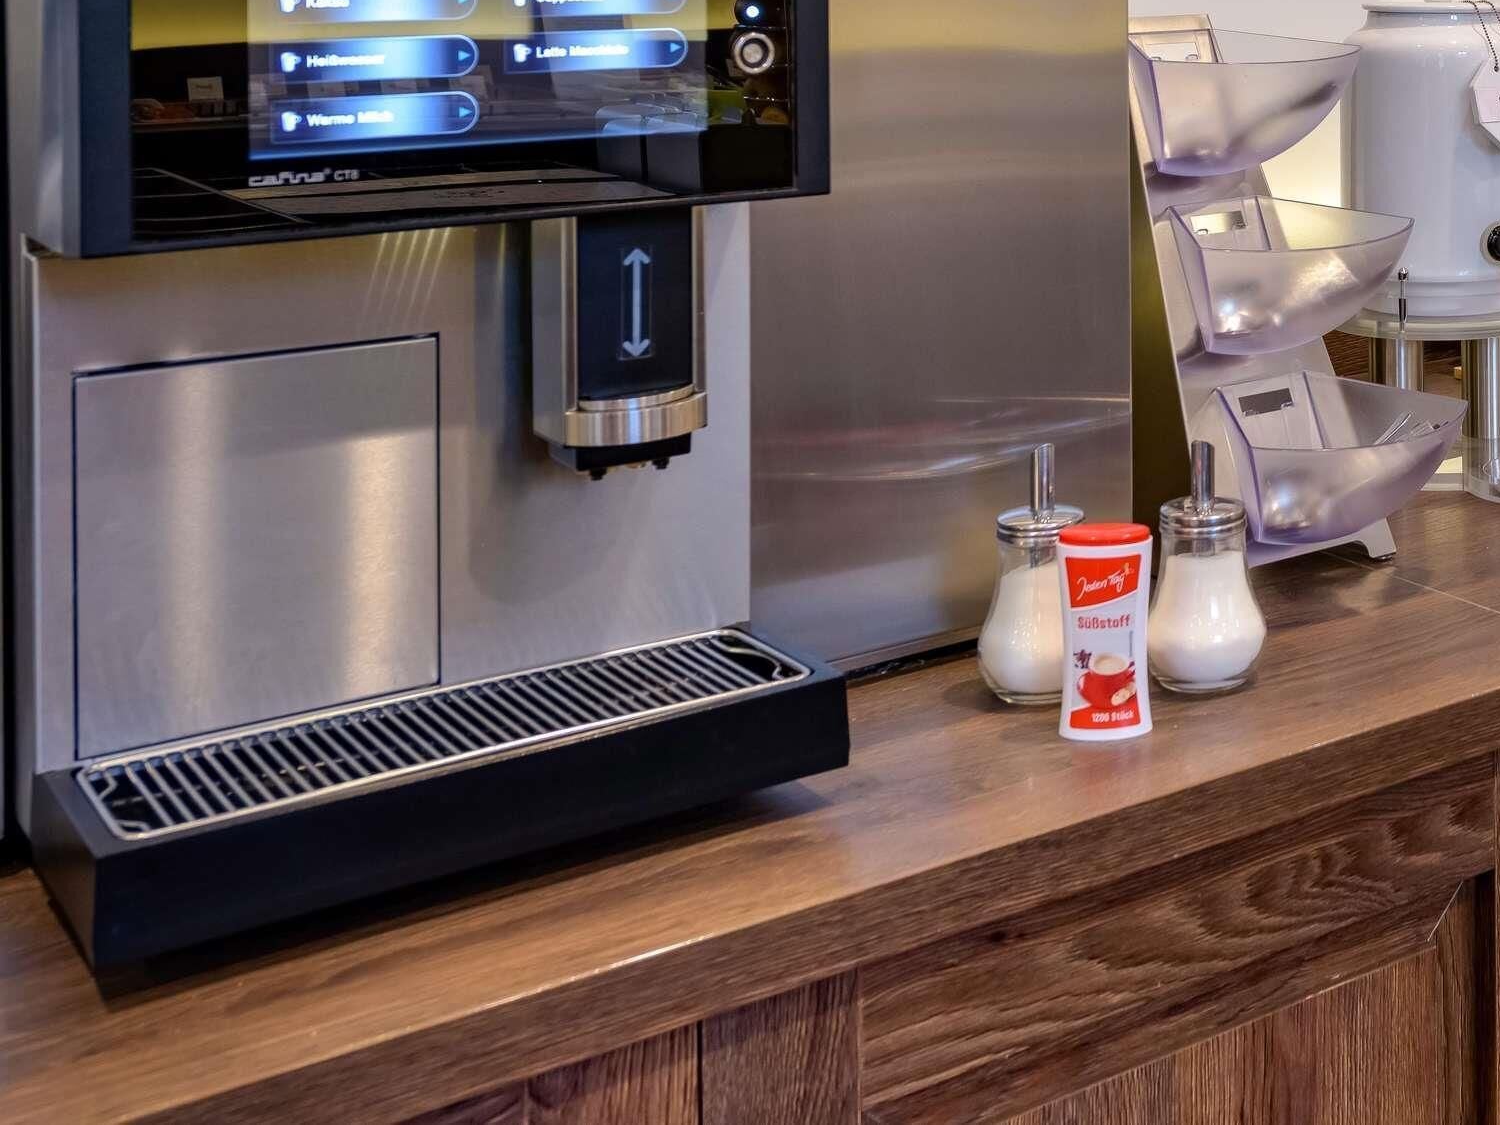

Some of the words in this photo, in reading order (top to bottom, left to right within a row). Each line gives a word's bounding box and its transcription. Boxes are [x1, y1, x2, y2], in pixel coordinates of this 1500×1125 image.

[536, 46, 568, 59] Latte
[306, 113, 355, 127] Warme
[357, 109, 395, 124] Milch
[333, 169, 360, 181] CT8
[1077, 577, 1108, 601] Jeden
[1077, 613, 1131, 630] Süßstoff
